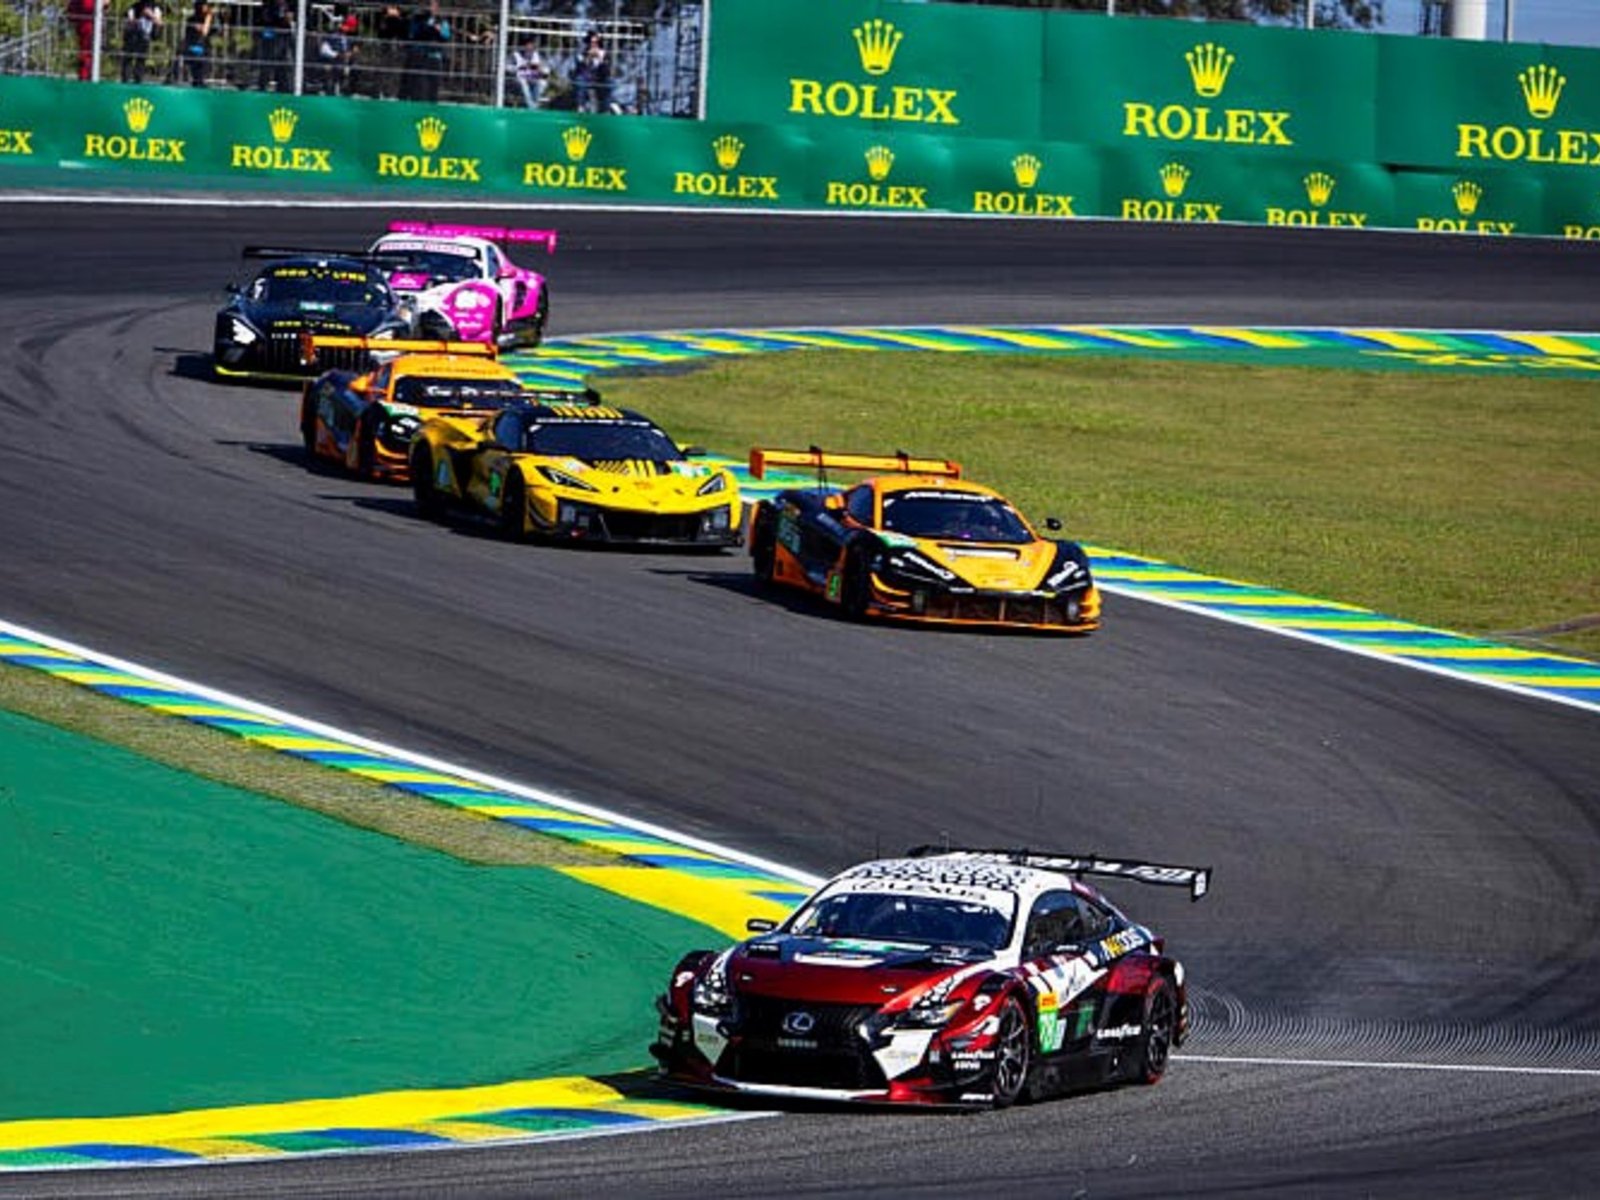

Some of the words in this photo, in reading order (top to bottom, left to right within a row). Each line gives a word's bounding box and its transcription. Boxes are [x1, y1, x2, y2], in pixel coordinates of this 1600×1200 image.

[790, 79, 959, 125] ROLEX
[1123, 102, 1293, 146] ROLEX
[84, 133, 185, 162] ROLEX
[232, 144, 332, 172] ROLEX
[377, 152, 480, 182] ROLEX
[523, 162, 627, 190] ROLEX
[674, 172, 779, 199] ROLEX
[826, 182, 927, 209] ROLEX
[973, 191, 1075, 217] ROLEX
[1121, 200, 1222, 223] ROLEX
[1265, 207, 1367, 228] ROLEX
